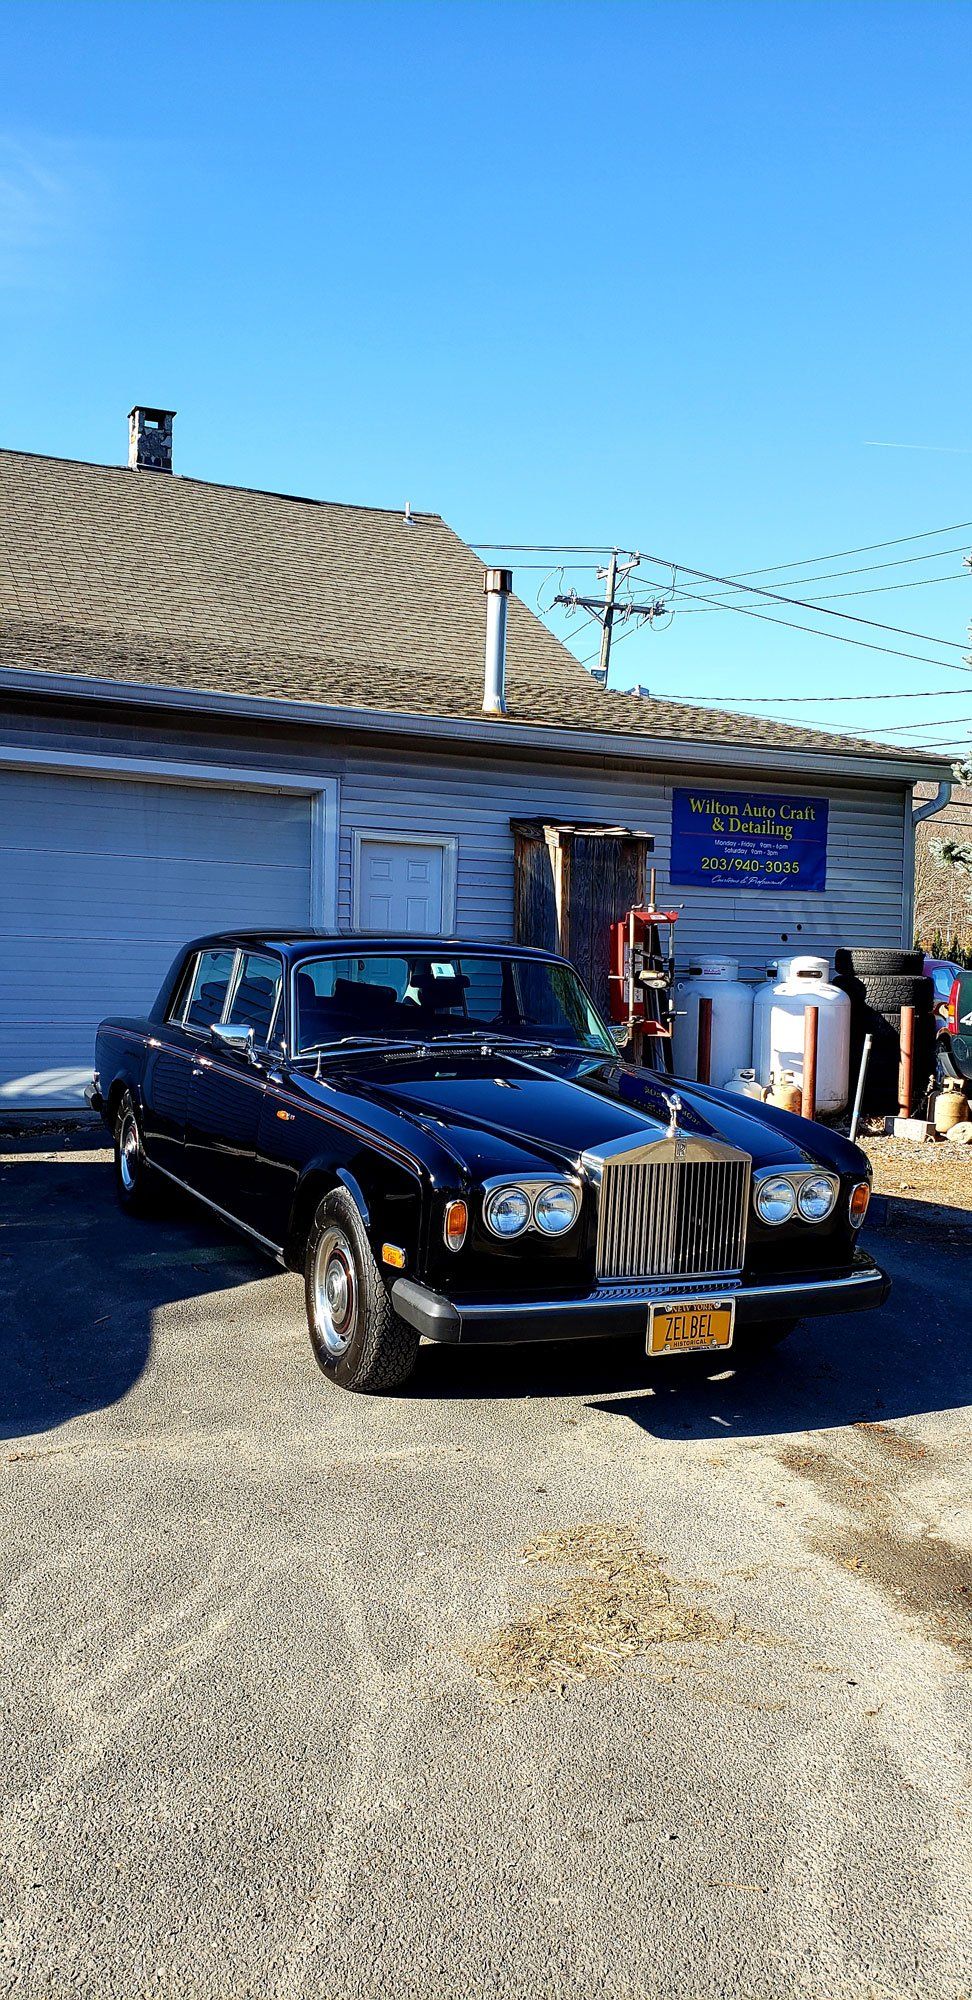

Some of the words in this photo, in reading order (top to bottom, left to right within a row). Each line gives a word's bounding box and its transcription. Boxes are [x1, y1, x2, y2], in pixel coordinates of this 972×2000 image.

[689, 797, 739, 815] Wilton
[742, 802, 776, 818] Auto
[779, 804, 816, 821] Craft
[712, 817, 724, 832] &
[728, 818, 793, 840] Detailing
[714, 839, 737, 847] Monday
[701, 857, 800, 874] 203/940-3035
[671, 1304, 691, 1313] NEW
[693, 1303, 714, 1311] YORK
[665, 1314, 714, 1342] ZELBEL
[673, 1338, 707, 1347] HISTORICAL
